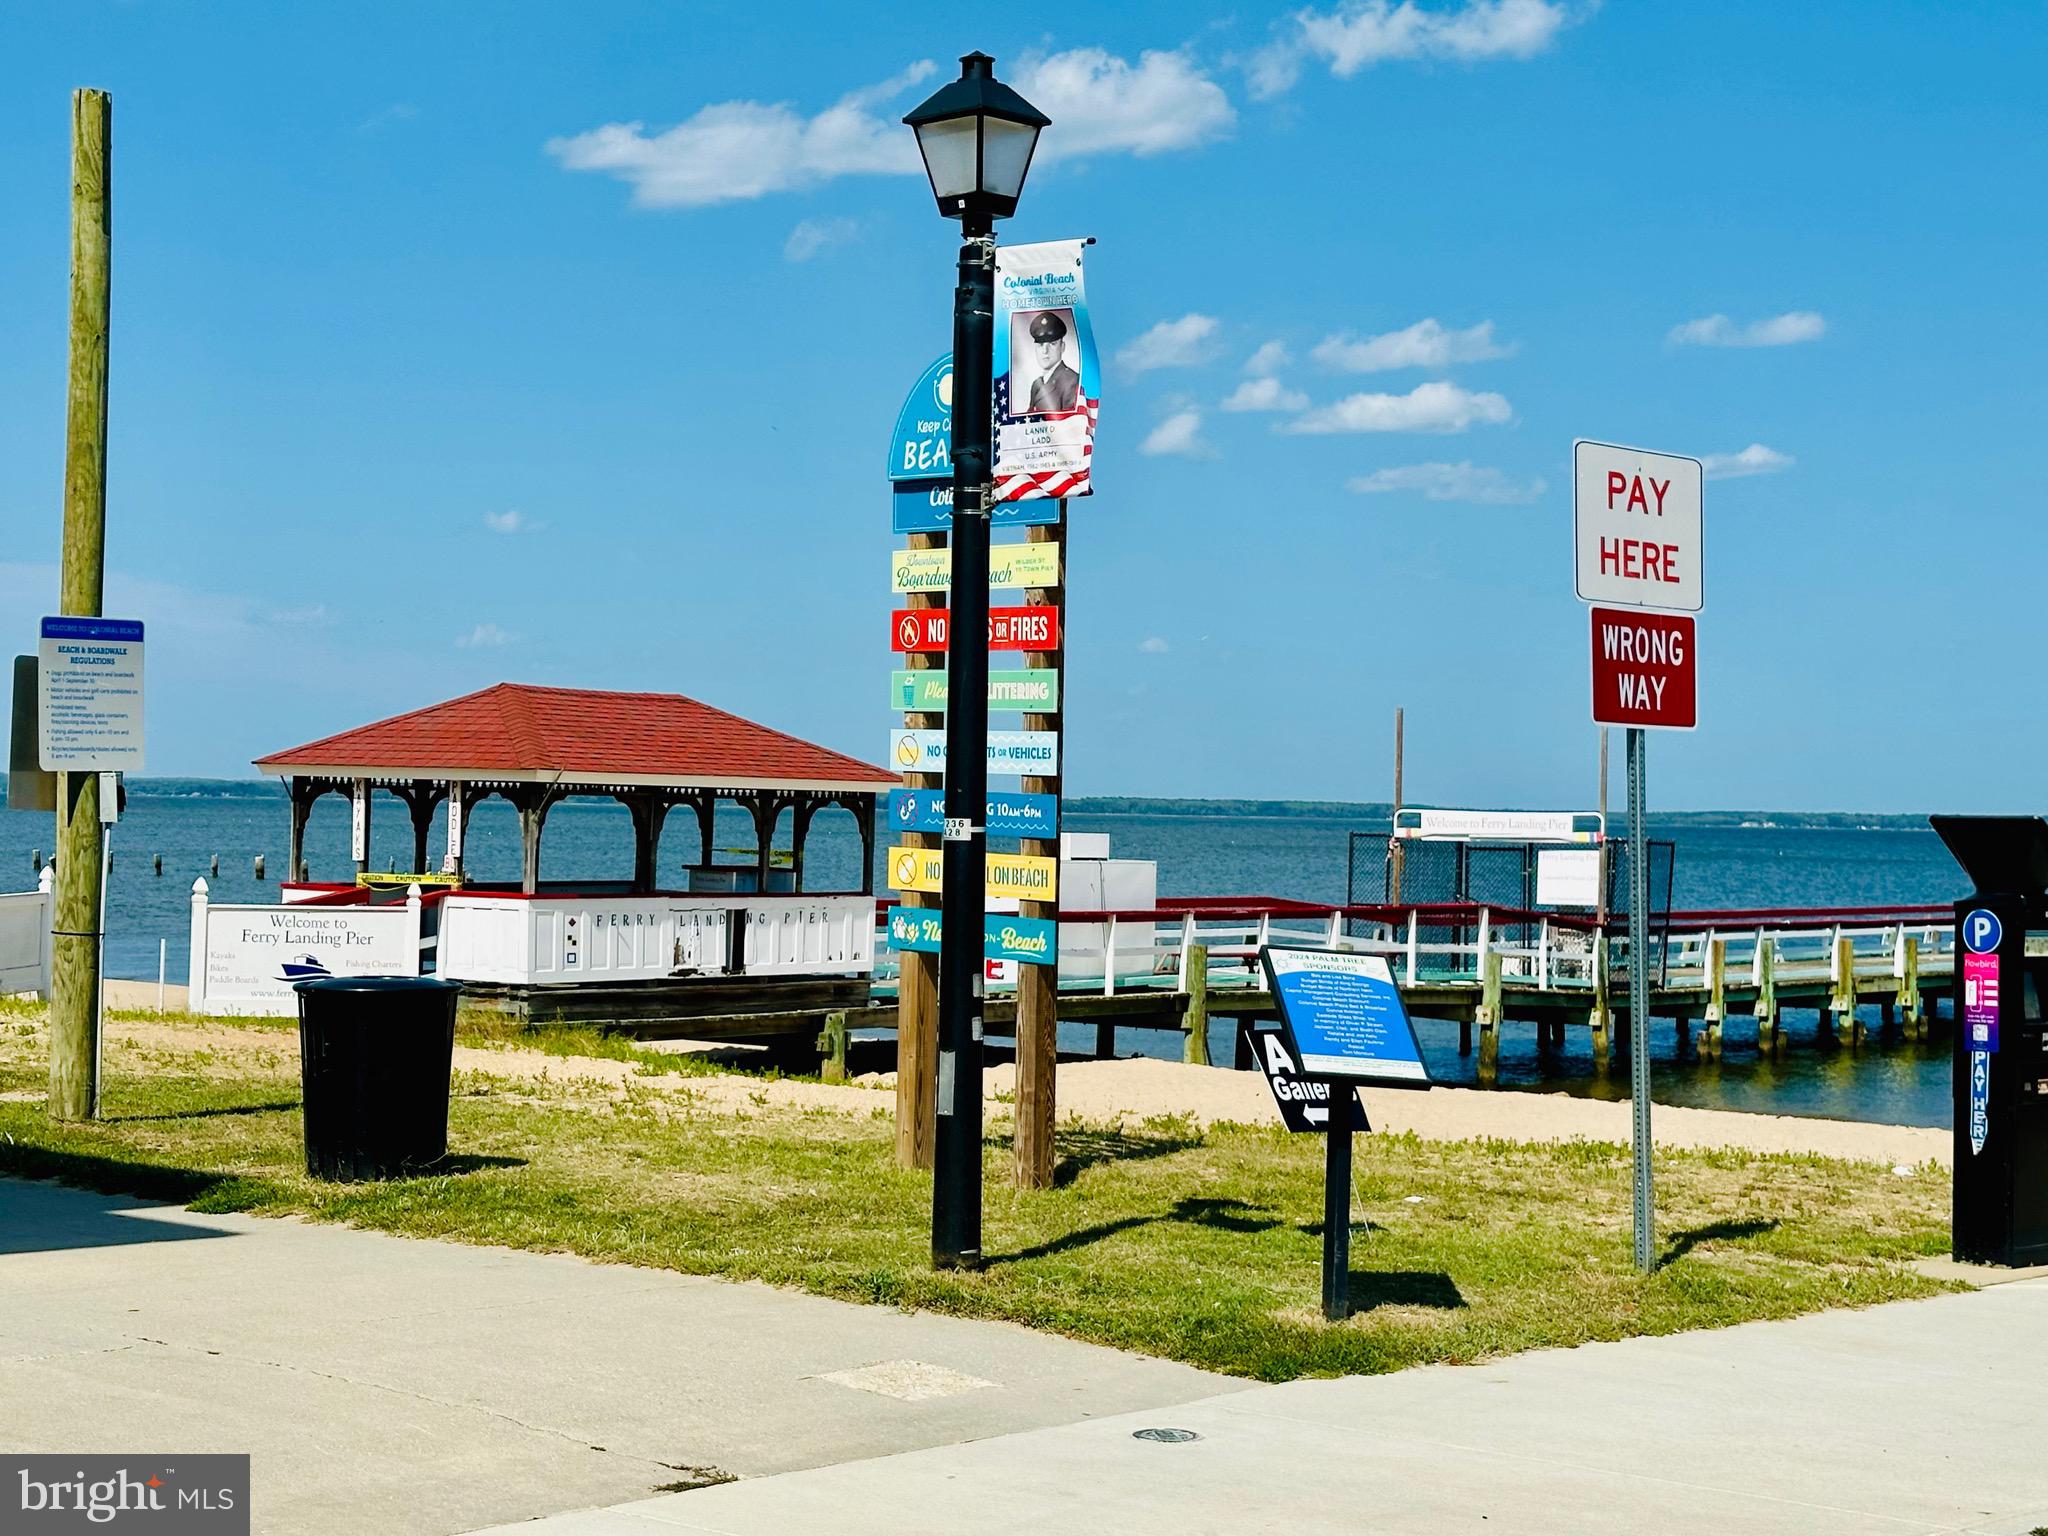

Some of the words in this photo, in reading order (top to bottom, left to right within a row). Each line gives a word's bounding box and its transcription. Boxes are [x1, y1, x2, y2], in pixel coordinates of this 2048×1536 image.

[1003, 274, 1042, 288] Colonial
[1044, 272, 1075, 284] Beach
[1001, 296, 1055, 309] HOMETOWN
[917, 420, 940, 437] Keep
[1025, 426, 1048, 435] LANNY
[1031, 436, 1051, 444] LADD
[903, 438, 948, 470] BEA
[930, 486, 954, 506] Col
[1607, 470, 1671, 517] PAY
[1600, 536, 1681, 583] HERE
[989, 562, 1012, 583] ach
[928, 617, 946, 643] NO
[995, 622, 1007, 638] OR
[1010, 615, 1048, 641] FIRES
[58, 645, 80, 653] BEACH
[87, 646, 127, 655] BOARDWALK
[1602, 623, 1684, 667] WRONG
[71, 657, 115, 665] REGULATIONS
[924, 681, 948, 699] Plea
[988, 682, 1049, 700] LITTERING
[1618, 672, 1668, 711] WAY
[927, 745, 940, 757] NO
[1009, 747, 1052, 760] VEHICLES
[1426, 816, 1468, 828] Welcome
[1470, 818, 1479, 828] to
[1481, 817, 1506, 830] Ferry
[1509, 817, 1547, 832] Landing
[1549, 818, 1568, 830] Pier
[435, 876, 460, 884] CAUTION
[926, 862, 940, 880] NO
[994, 866, 1010, 885] ON
[1012, 867, 1049, 888] BEACH
[270, 914, 330, 929] Welcome
[334, 919, 348, 929] to
[596, 913, 655, 927] FERRY
[679, 911, 766, 927] LANDNG
[784, 910, 828, 924] PIER
[242, 928, 280, 947] Ferry
[285, 930, 342, 949] Landing
[345, 931, 374, 945] Pier
[1001, 926, 1047, 952] Beach
[1973, 917, 1991, 947] P
[210, 951, 236, 960] Kayaks
[345, 959, 370, 969] Fishing
[371, 959, 402, 968] Charters
[1312, 954, 1340, 963] PALM
[1342, 956, 1366, 965] TREE
[210, 964, 229, 972] Bikes
[1303, 962, 1358, 972] SPONSORS
[209, 975, 234, 984] Paddle
[235, 976, 260, 984] Boards
[250, 990, 296, 998] www.ferry
[1263, 1033, 1297, 1075] A
[1974, 1051, 1986, 1092] PAY
[1272, 1076, 1330, 1101] Galler
[1973, 1096, 1986, 1151] HERE
